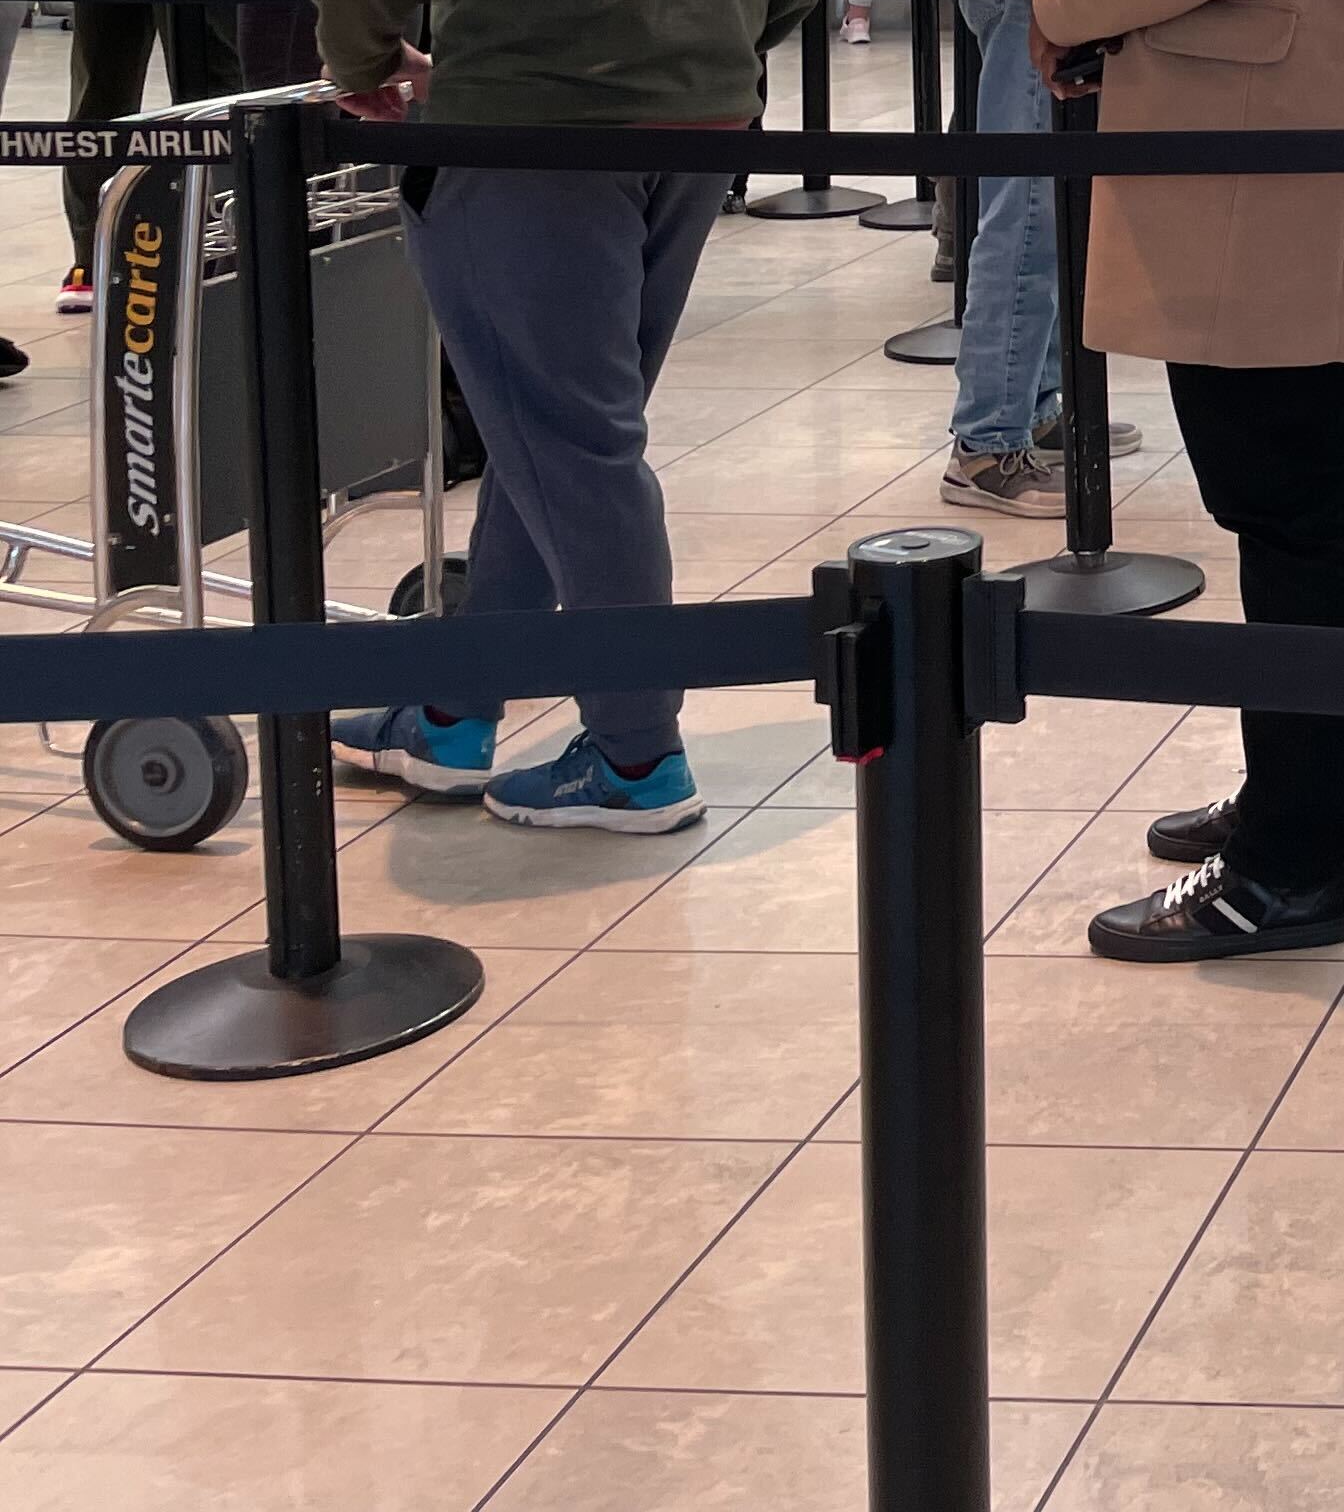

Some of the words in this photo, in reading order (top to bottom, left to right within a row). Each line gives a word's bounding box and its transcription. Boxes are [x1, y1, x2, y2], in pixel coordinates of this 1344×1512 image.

[0, 131, 118, 158] HWEST
[126, 129, 232, 157] AIRLIN
[113, 221, 163, 537] smartecarte
